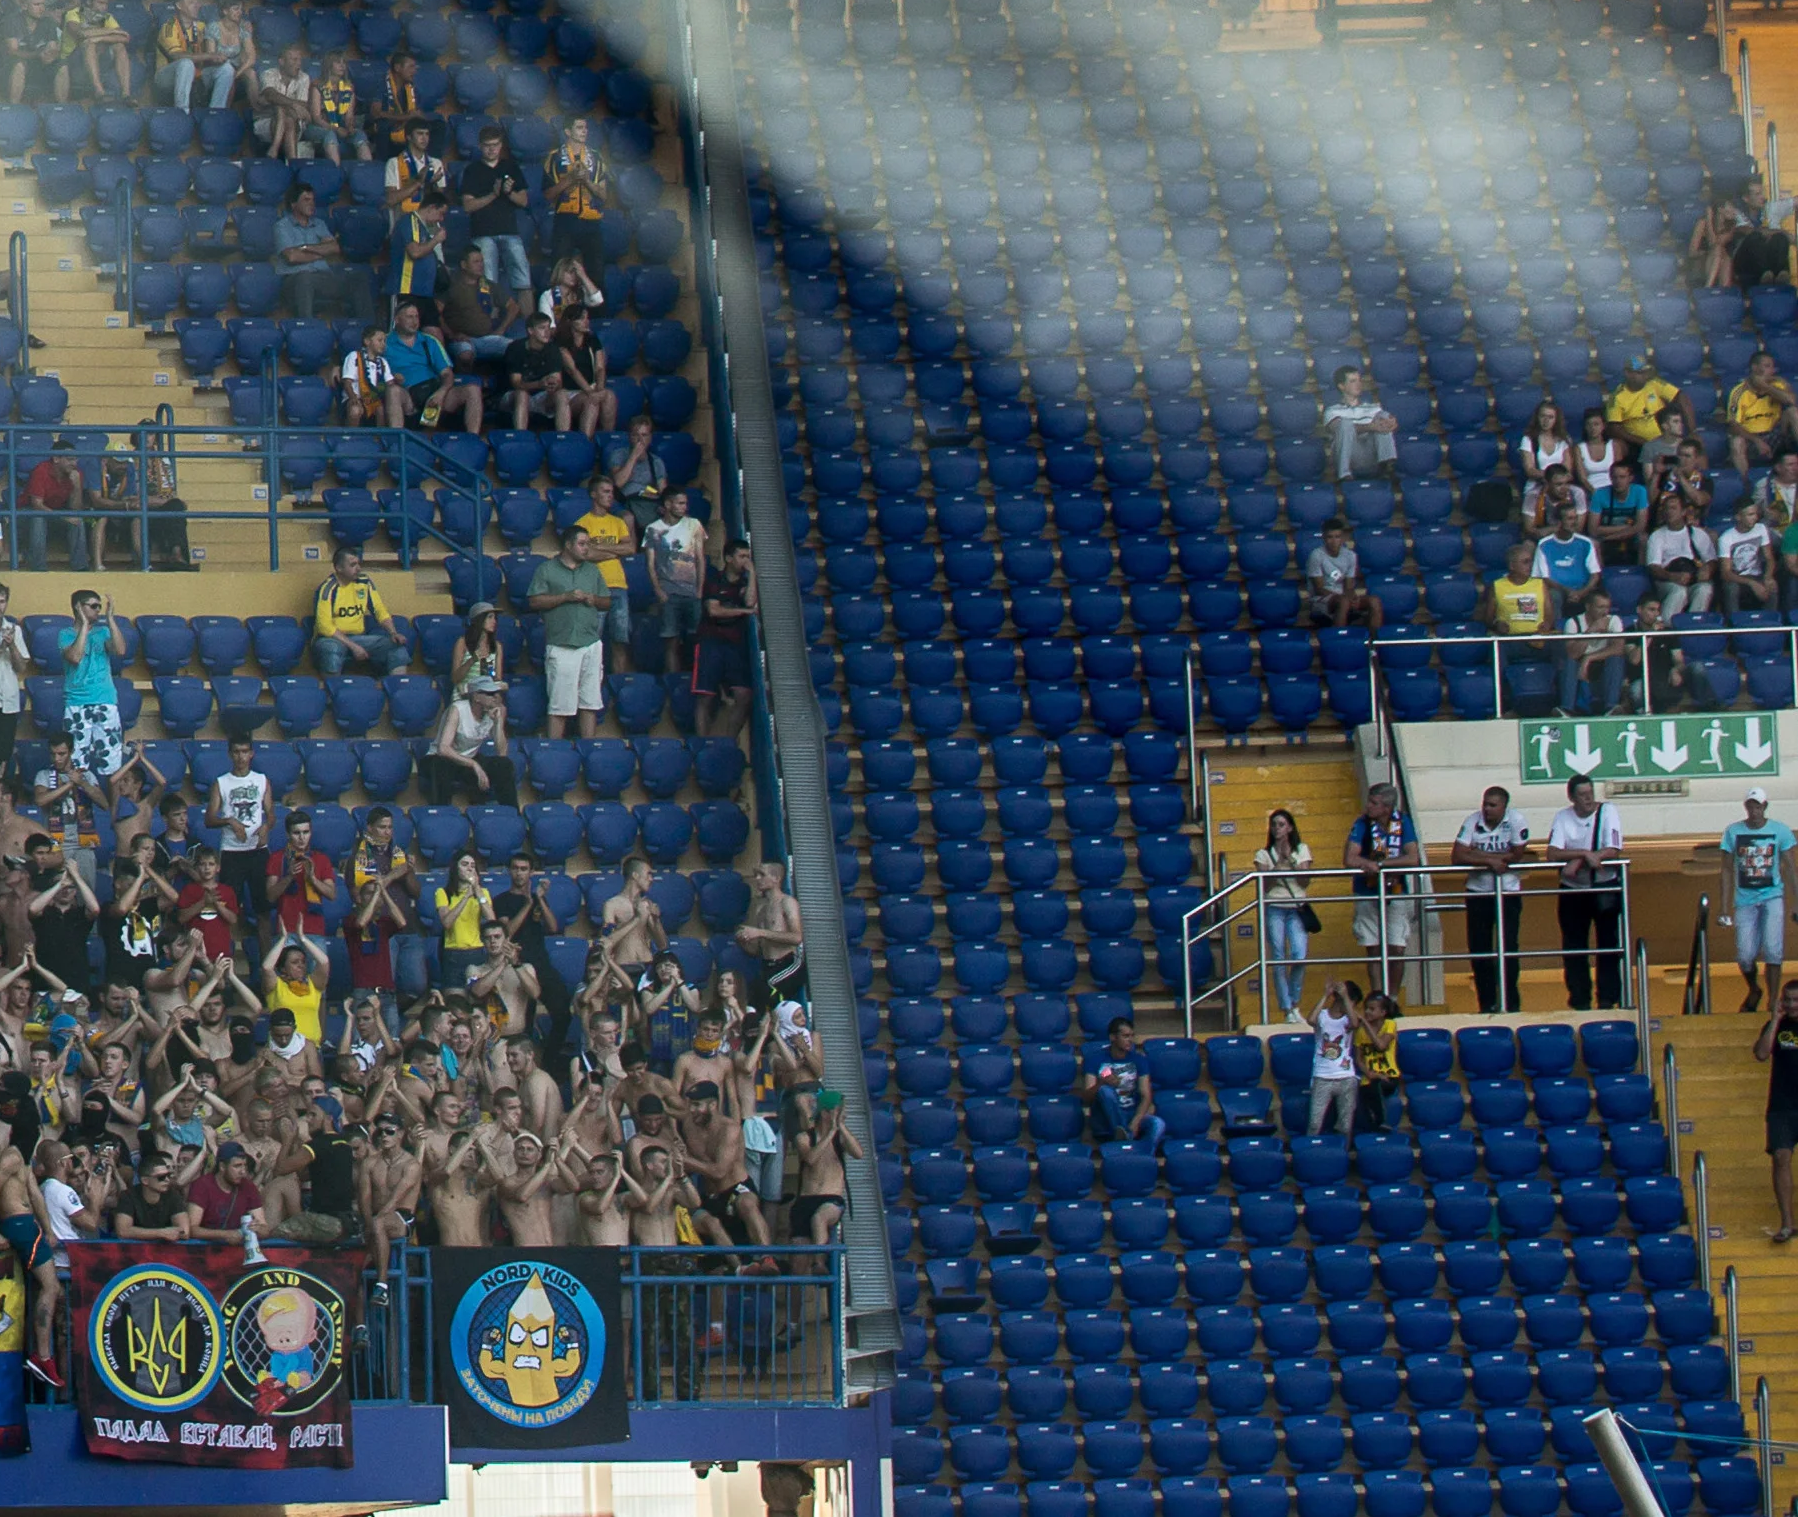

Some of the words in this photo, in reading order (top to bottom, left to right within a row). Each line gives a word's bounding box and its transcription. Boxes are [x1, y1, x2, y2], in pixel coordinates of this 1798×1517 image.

[339, 605, 364, 618] DCH
[262, 1272, 300, 1287] AND
[480, 1264, 531, 1292] NORD
[542, 1266, 582, 1297] KIDS
[119, 1283, 141, 1302] ПУТЬ
[460, 1368, 523, 1423] ЗАТОЧЕНЫ
[525, 1412, 545, 1424] НА
